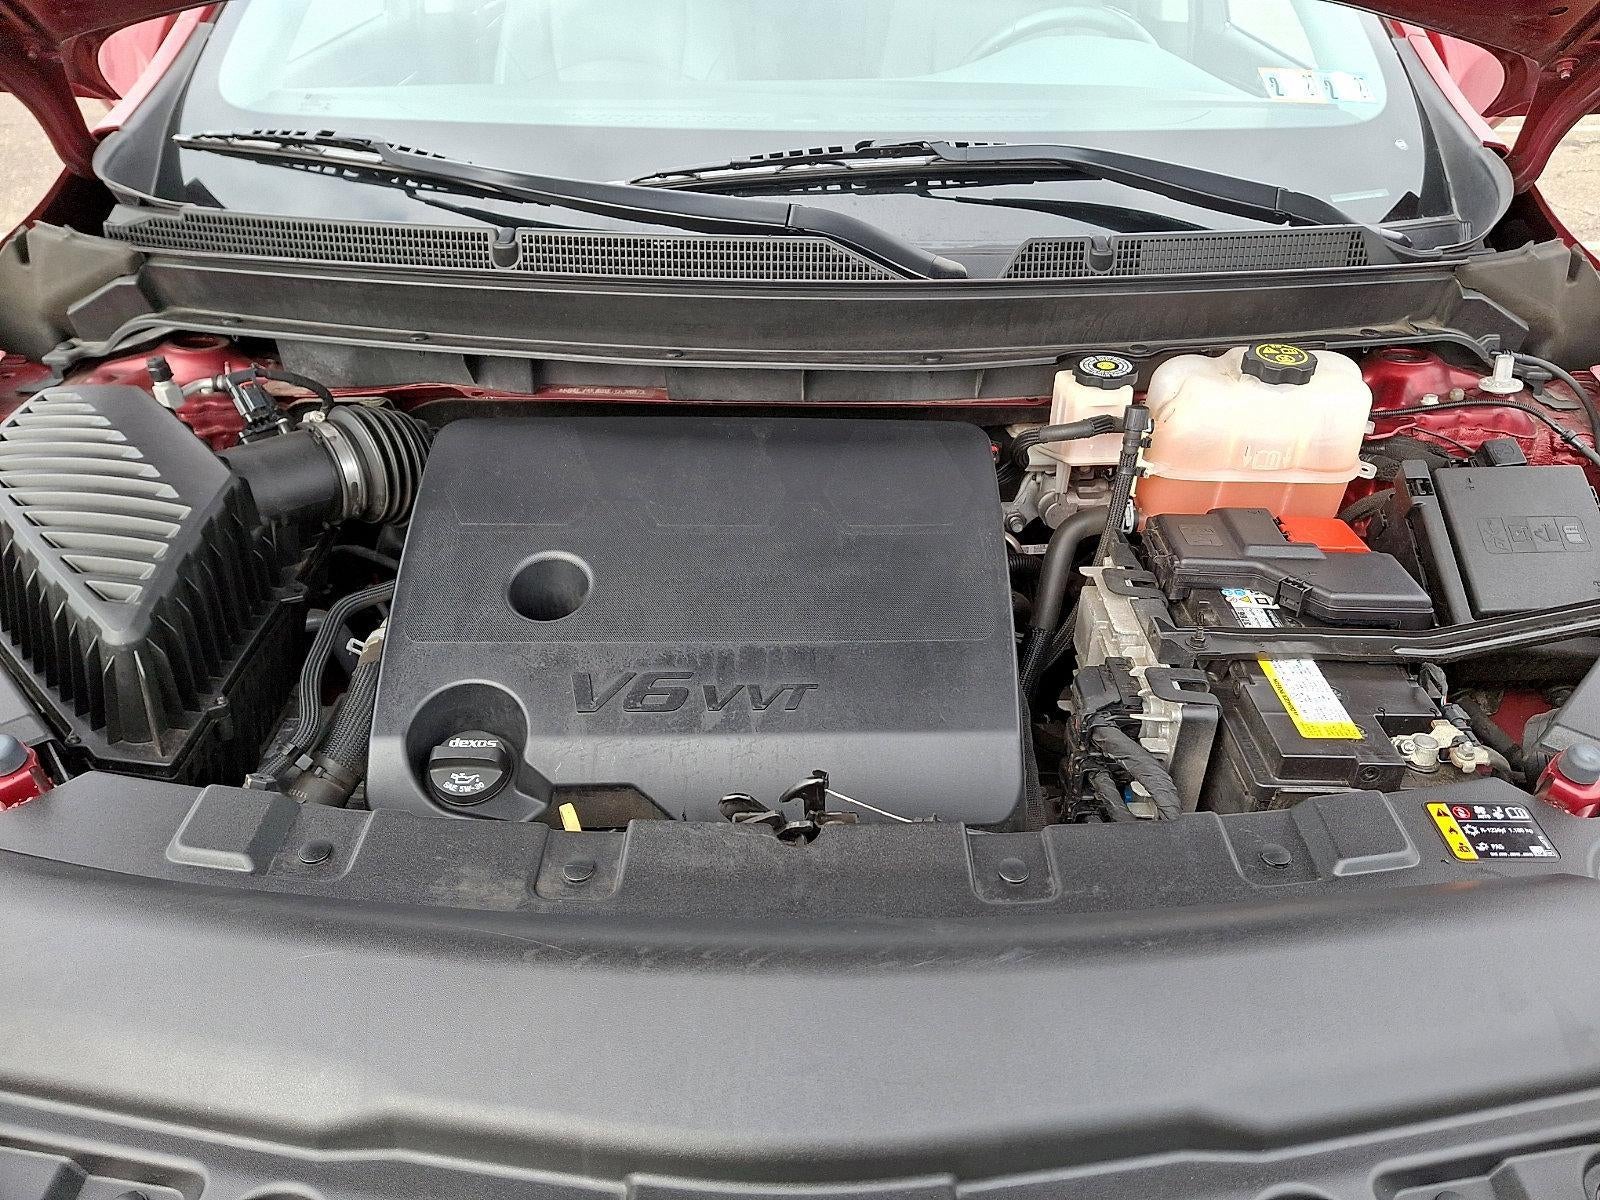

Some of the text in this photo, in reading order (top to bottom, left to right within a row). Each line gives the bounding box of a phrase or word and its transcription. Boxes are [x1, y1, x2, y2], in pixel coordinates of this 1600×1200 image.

[571, 671, 819, 713] V6 VVT
[448, 737, 499, 748] dexos
[443, 781, 485, 793] SAE 5W-30
